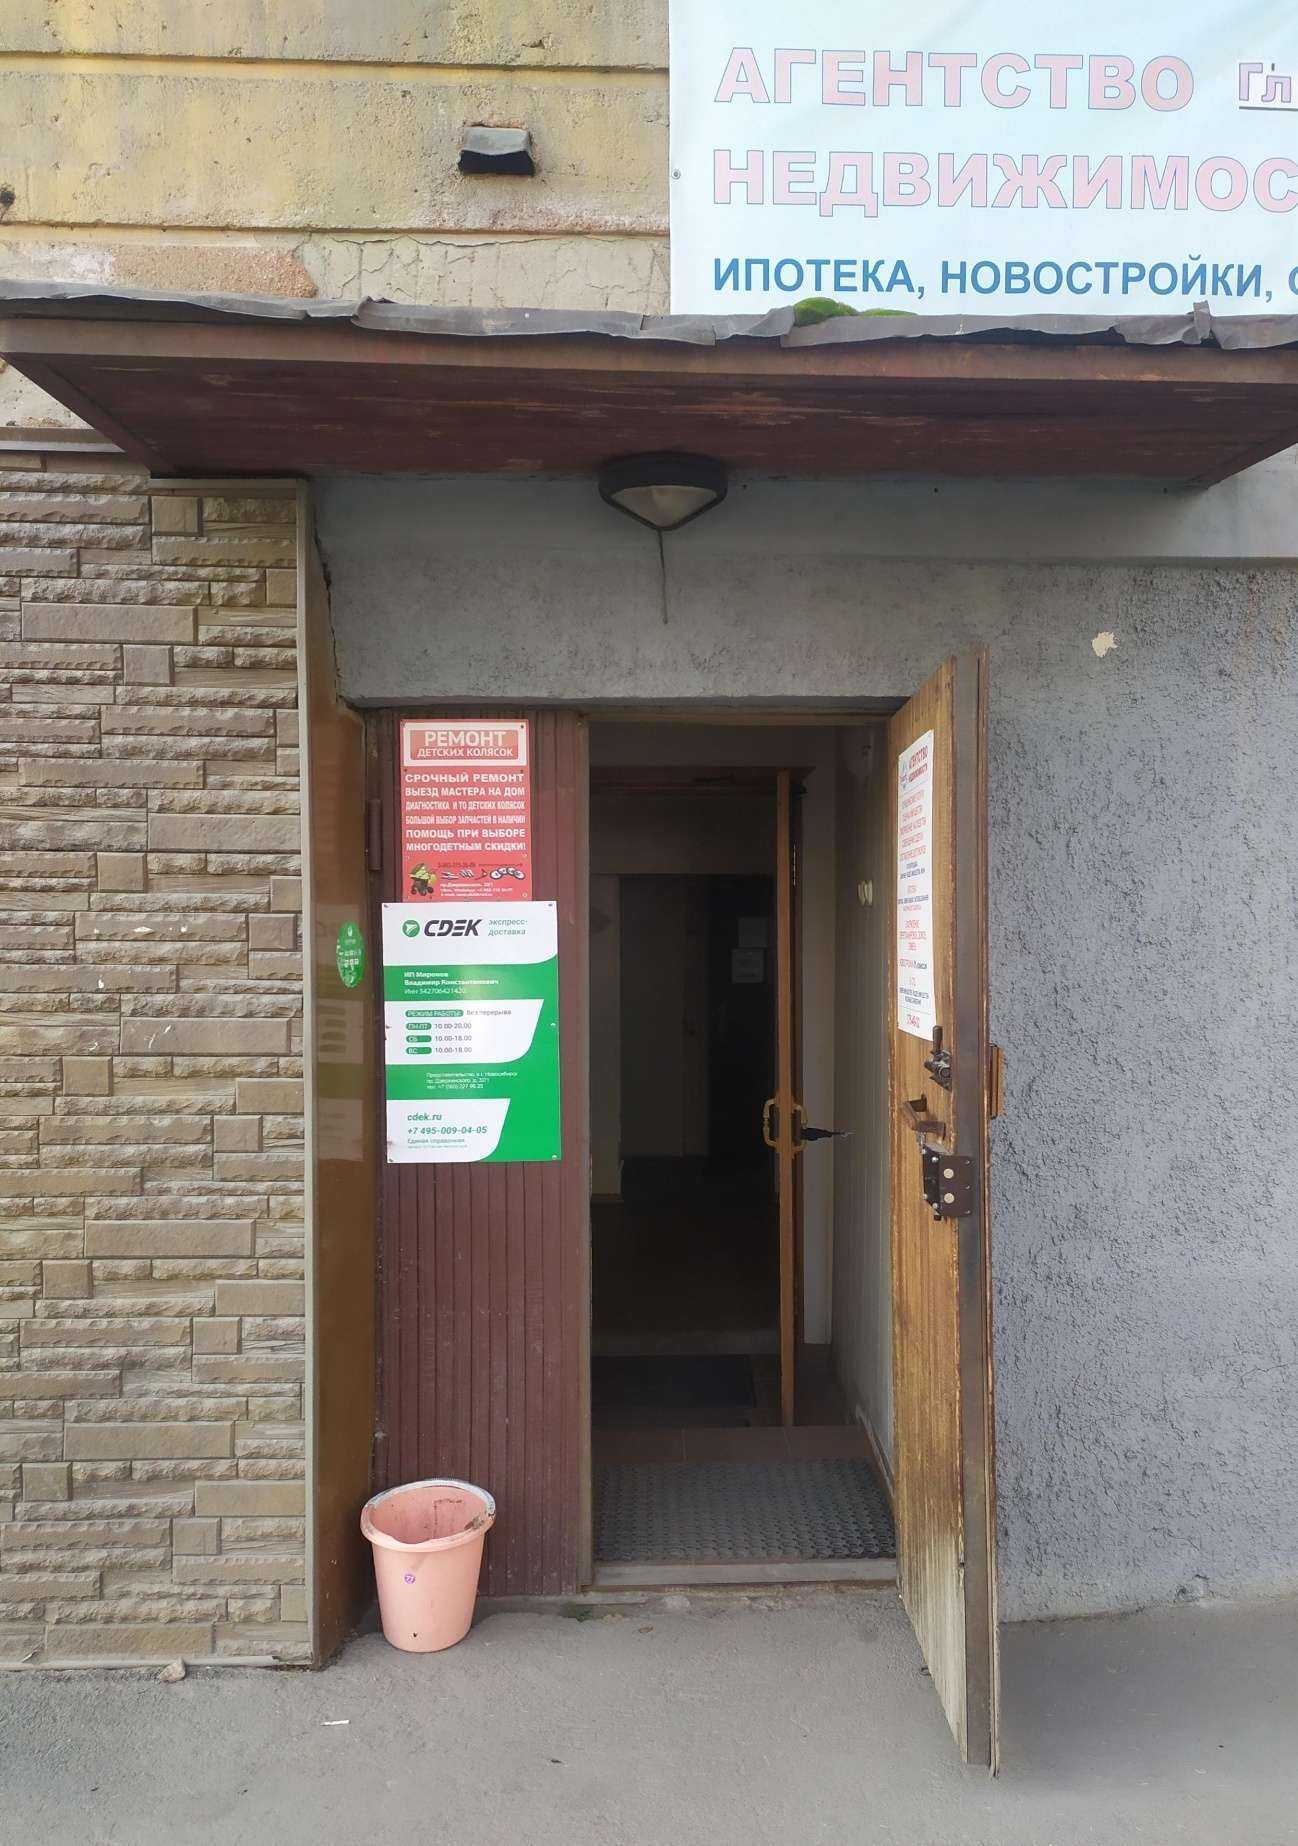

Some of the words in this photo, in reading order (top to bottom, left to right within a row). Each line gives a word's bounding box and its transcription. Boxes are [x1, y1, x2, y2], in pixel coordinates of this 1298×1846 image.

[713, 47, 1195, 111] АГЕНТСТВО
[713, 149, 1298, 218] НЕДВИЖИМОС
[713, 258, 925, 300] ИПОТЕКА,
[940, 254, 1273, 303] НОВОСТРОЙКИ,
[424, 730, 507, 747] РЕМОНТ
[417, 748, 464, 758] ДЕТСКИХ
[466, 748, 514, 757] КОЛЯСОК
[405, 772, 469, 783] СРОЧНЫЙ
[472, 773, 525, 783] РЕМОНТ
[405, 787, 439, 797] ВЫЕЗД
[440, 787, 486, 796] МАСТЕРА
[488, 787, 502, 796] НА
[503, 787, 525, 797] ДОМ
[405, 800, 450, 811] ДИАГНОСТИКА
[452, 801, 458, 810] И
[468, 801, 496, 811] ДЕТСКИХ
[497, 801, 525, 810] КОЛЯСОК
[405, 814, 435, 825] БОЛЬШОЙ
[436, 815, 457, 825] ВЫБОР
[406, 829, 455, 839] ПОМОЩЬ
[457, 829, 479, 838] ПРИ
[482, 828, 526, 838] ВЫБОРЕ
[406, 842, 482, 852] МНОГОДЕТНЫМ
[484, 842, 526, 852] СКИДКИ!
[424, 919, 483, 937] CDEK
[488, 928, 526, 936] доставка
[407, 1113, 442, 1121] cdek.ru
[420, 1126, 487, 1135] 495-009-04-05
